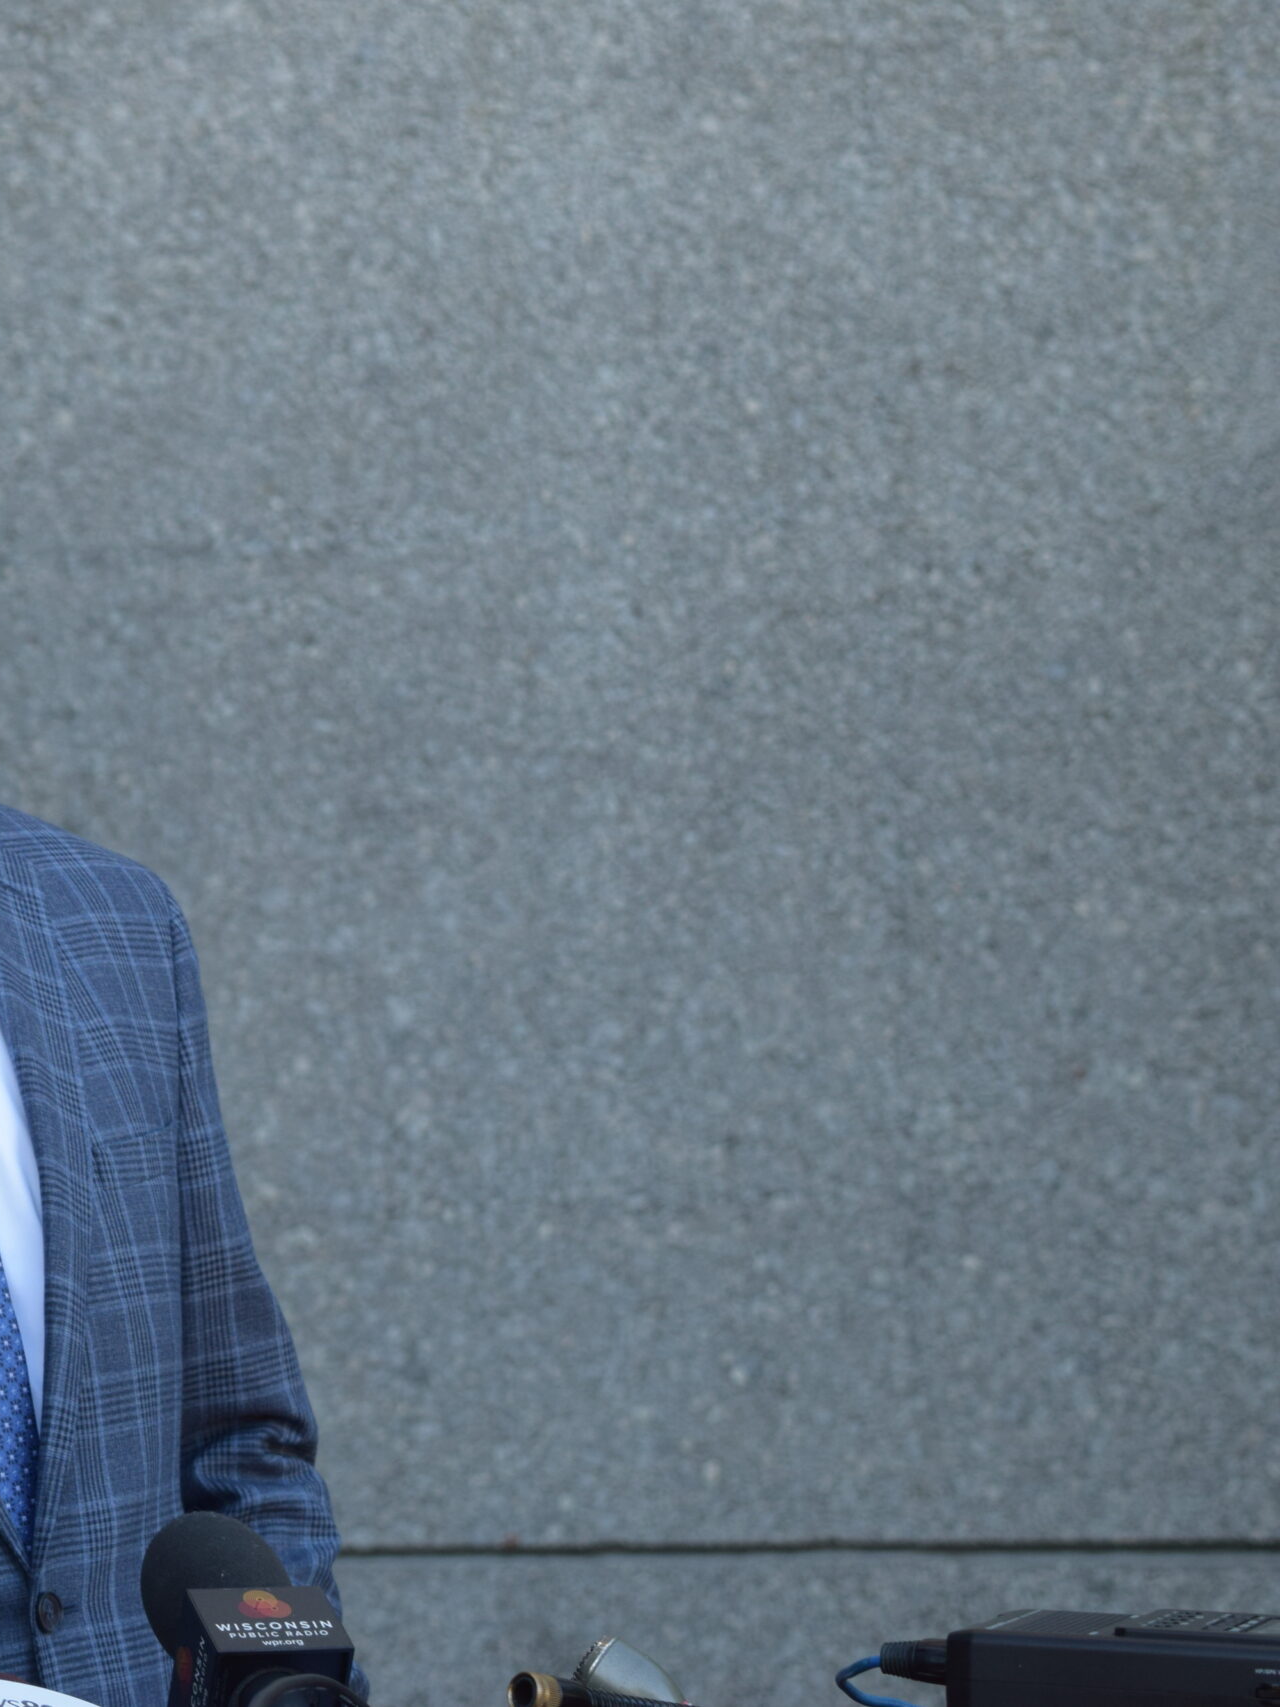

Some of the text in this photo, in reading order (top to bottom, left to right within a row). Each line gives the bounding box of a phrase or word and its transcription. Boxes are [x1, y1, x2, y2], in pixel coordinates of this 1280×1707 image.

[215, 1620, 334, 1632] WISCONSIN
[228, 1629, 329, 1639] PUBLIC RADIO
[262, 1639, 305, 1647] wpr.org
